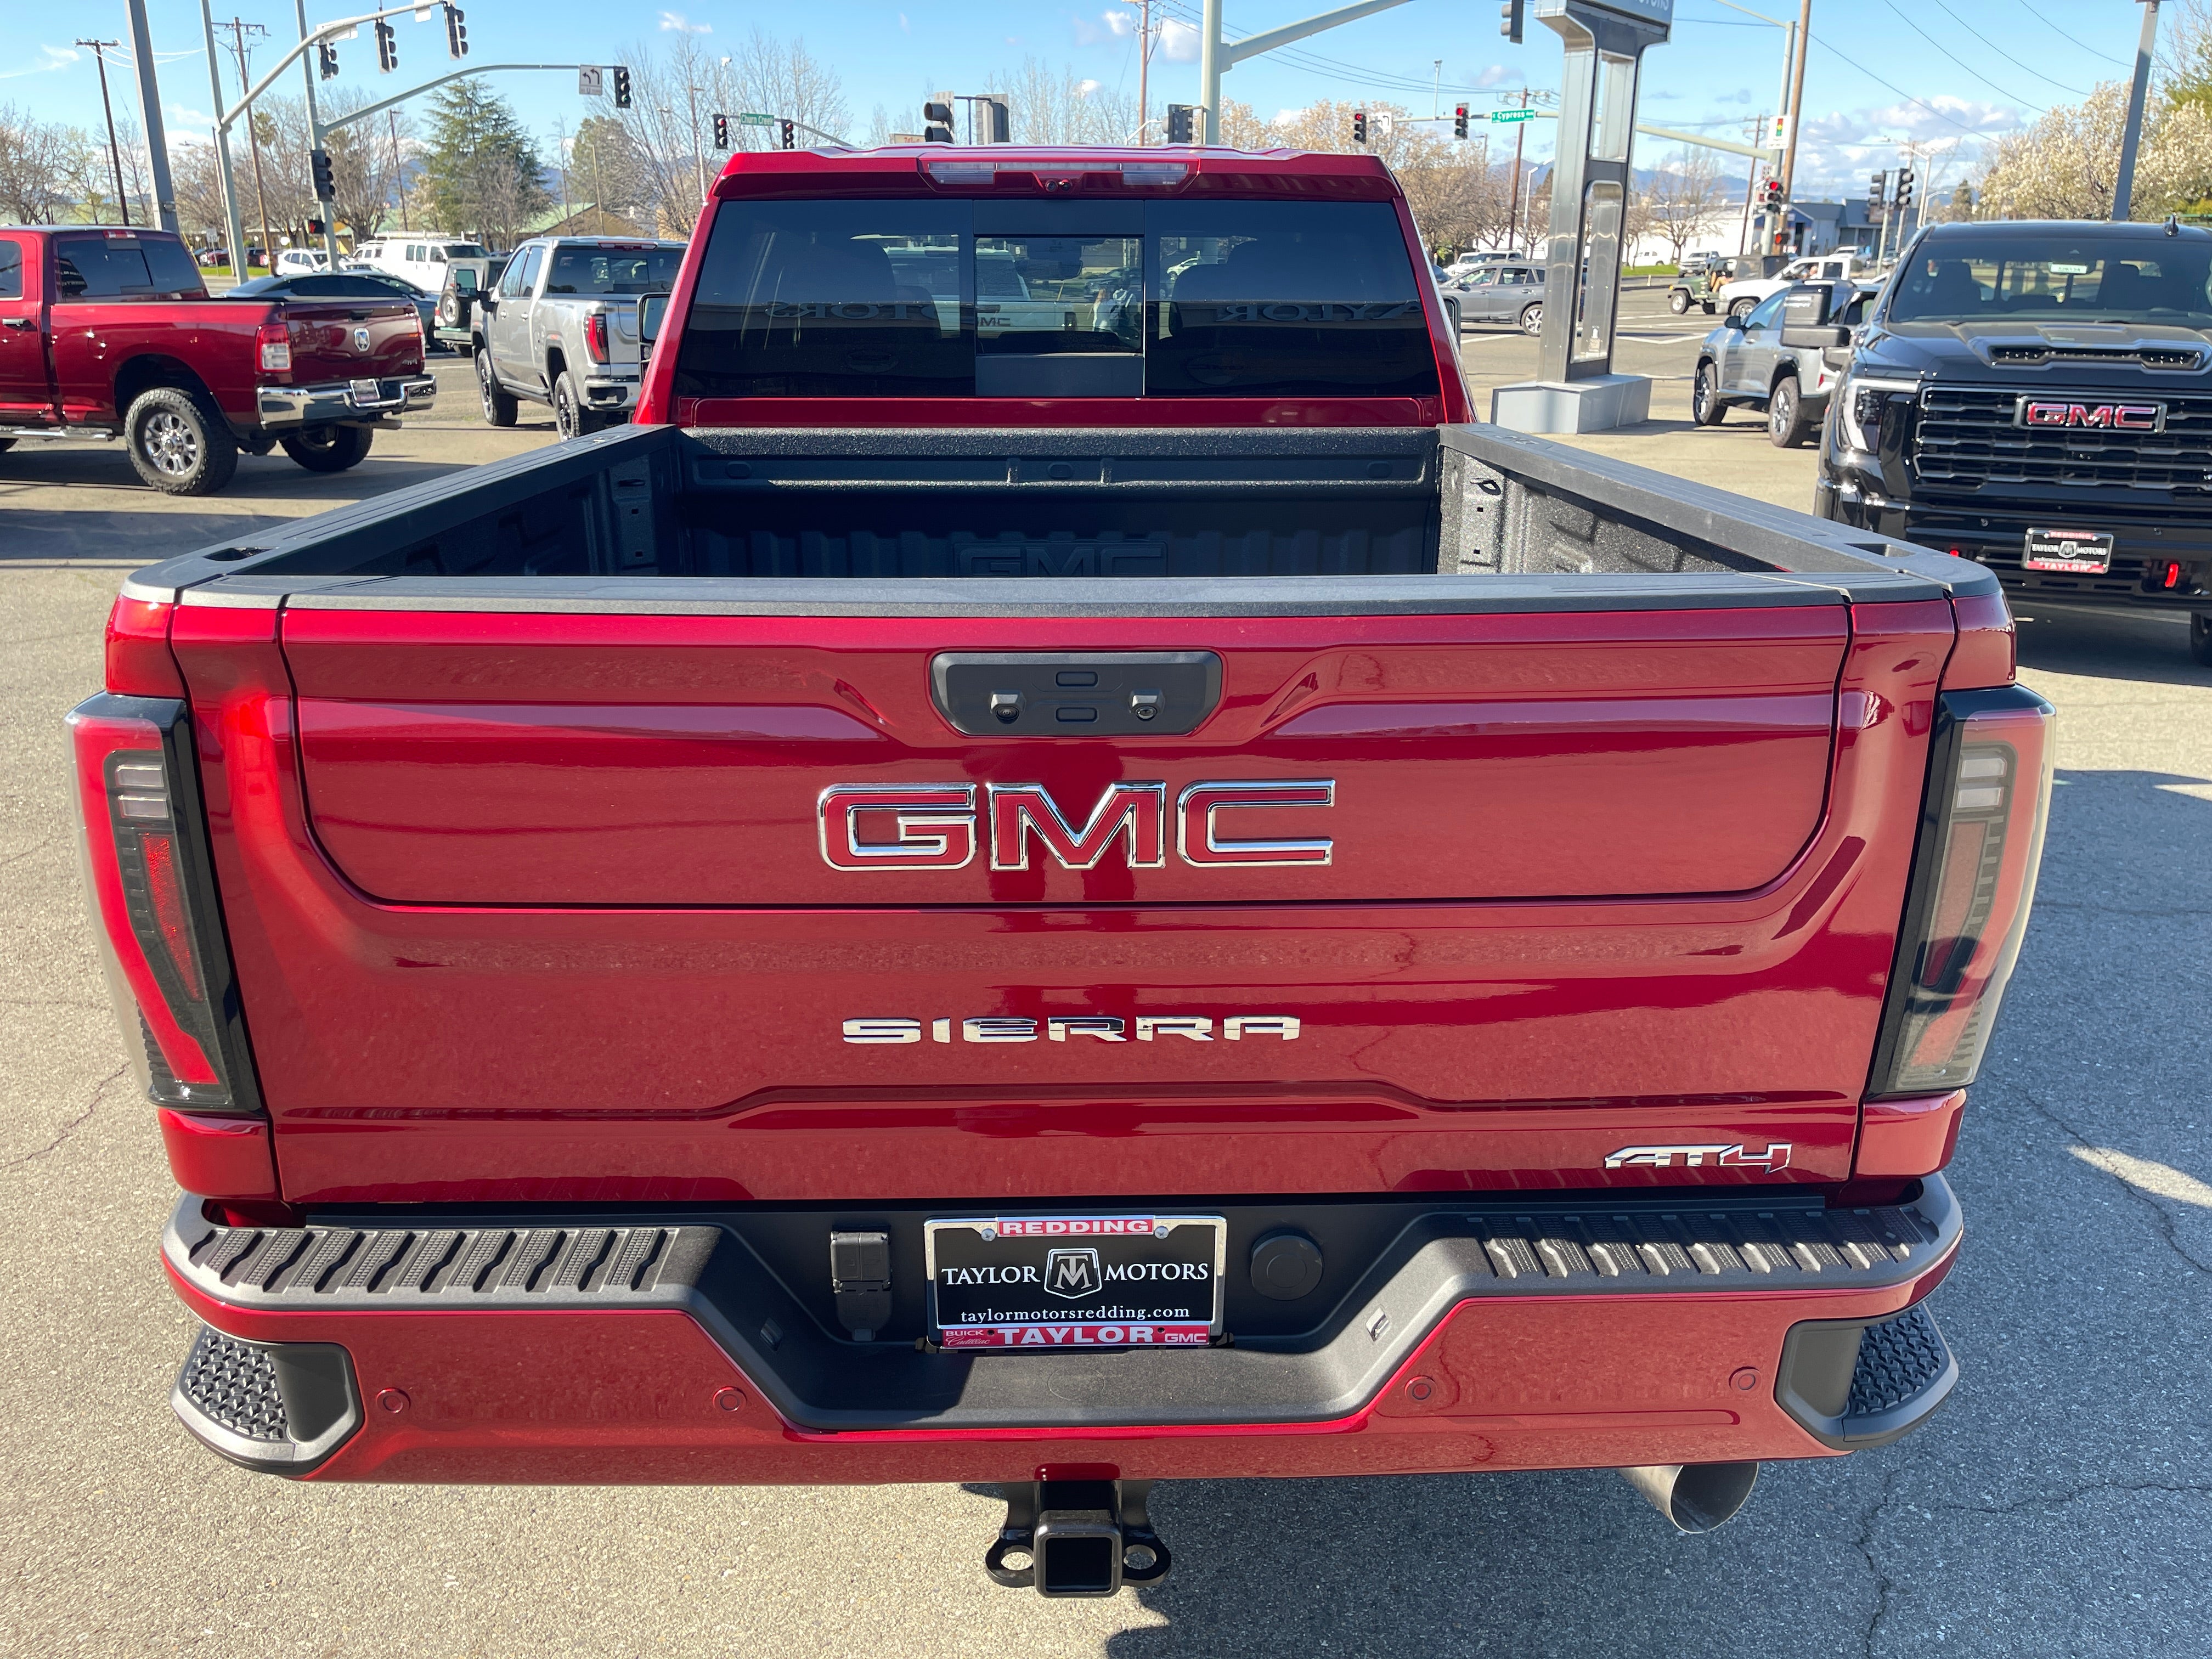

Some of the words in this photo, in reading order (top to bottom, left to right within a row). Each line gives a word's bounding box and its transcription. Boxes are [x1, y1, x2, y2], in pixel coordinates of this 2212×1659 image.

[1497, 111, 1525, 121] Cypress
[2027, 402, 2156, 428] GMC
[2032, 544, 2059, 553] TAYLOR
[2076, 546, 2107, 556] MOTORS
[2044, 562, 2088, 572] TAYLOR
[817, 779, 1335, 871] GMC
[843, 1015, 1300, 1043] SIERRA
[1605, 1144, 1792, 1175] AT4
[1002, 1220, 1149, 1235] REDDING
[941, 1265, 1041, 1285] TAYLOR
[1104, 1263, 1209, 1282] MOTORS
[961, 1305, 1190, 1324] taylormotorsredding.com
[945, 1336, 991, 1347] Cadillac
[997, 1327, 1153, 1345] TAYLOR
[1164, 1332, 1206, 1344] GMC
